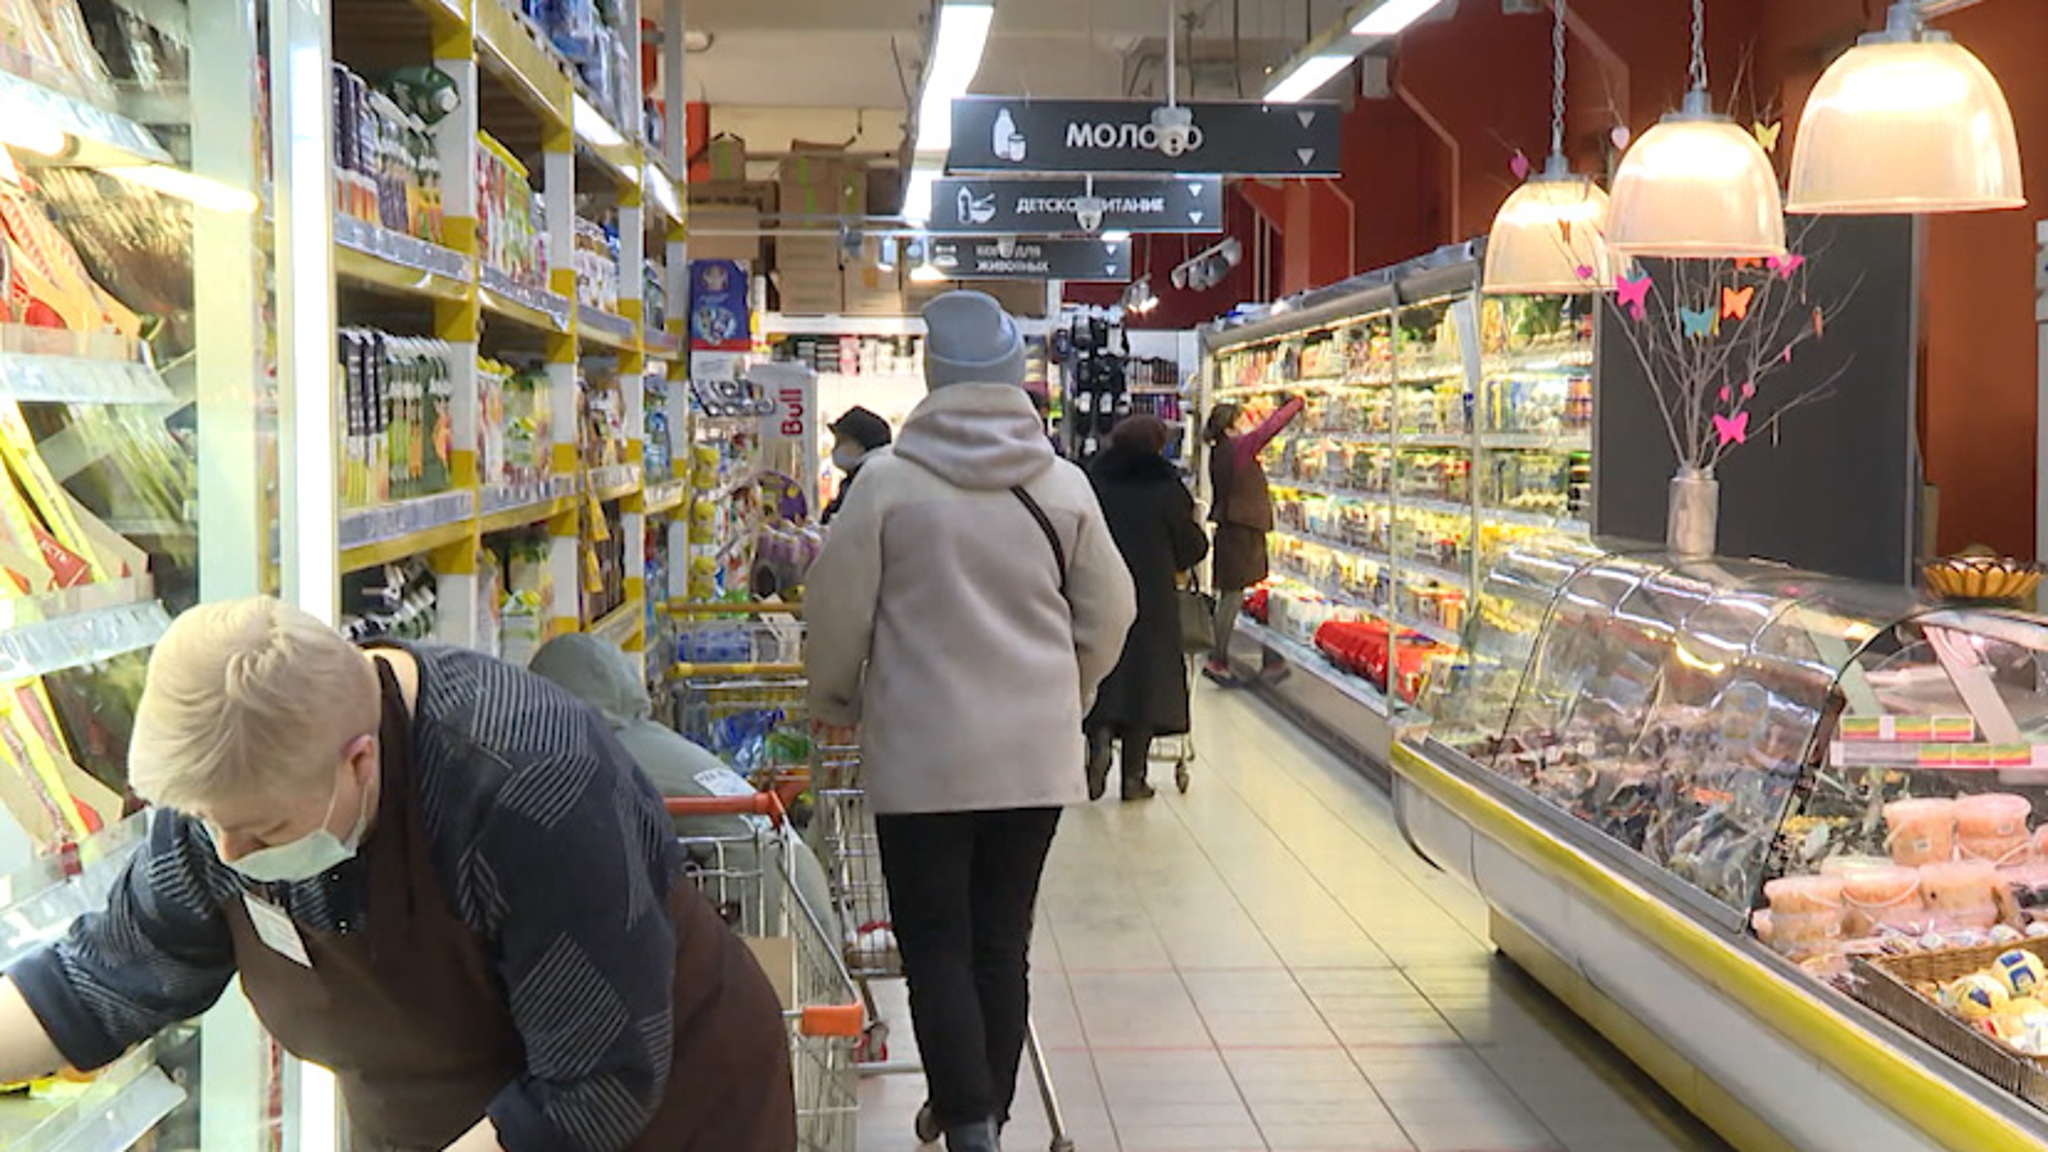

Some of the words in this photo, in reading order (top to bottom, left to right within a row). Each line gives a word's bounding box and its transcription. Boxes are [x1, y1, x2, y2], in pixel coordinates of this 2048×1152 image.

[1066, 122, 1203, 150] МОЛОО
[1016, 198, 1083, 214] ДЕТСКО
[1097, 198, 1166, 213] ИТАНИЕ
[780, 387, 803, 435] Bull
